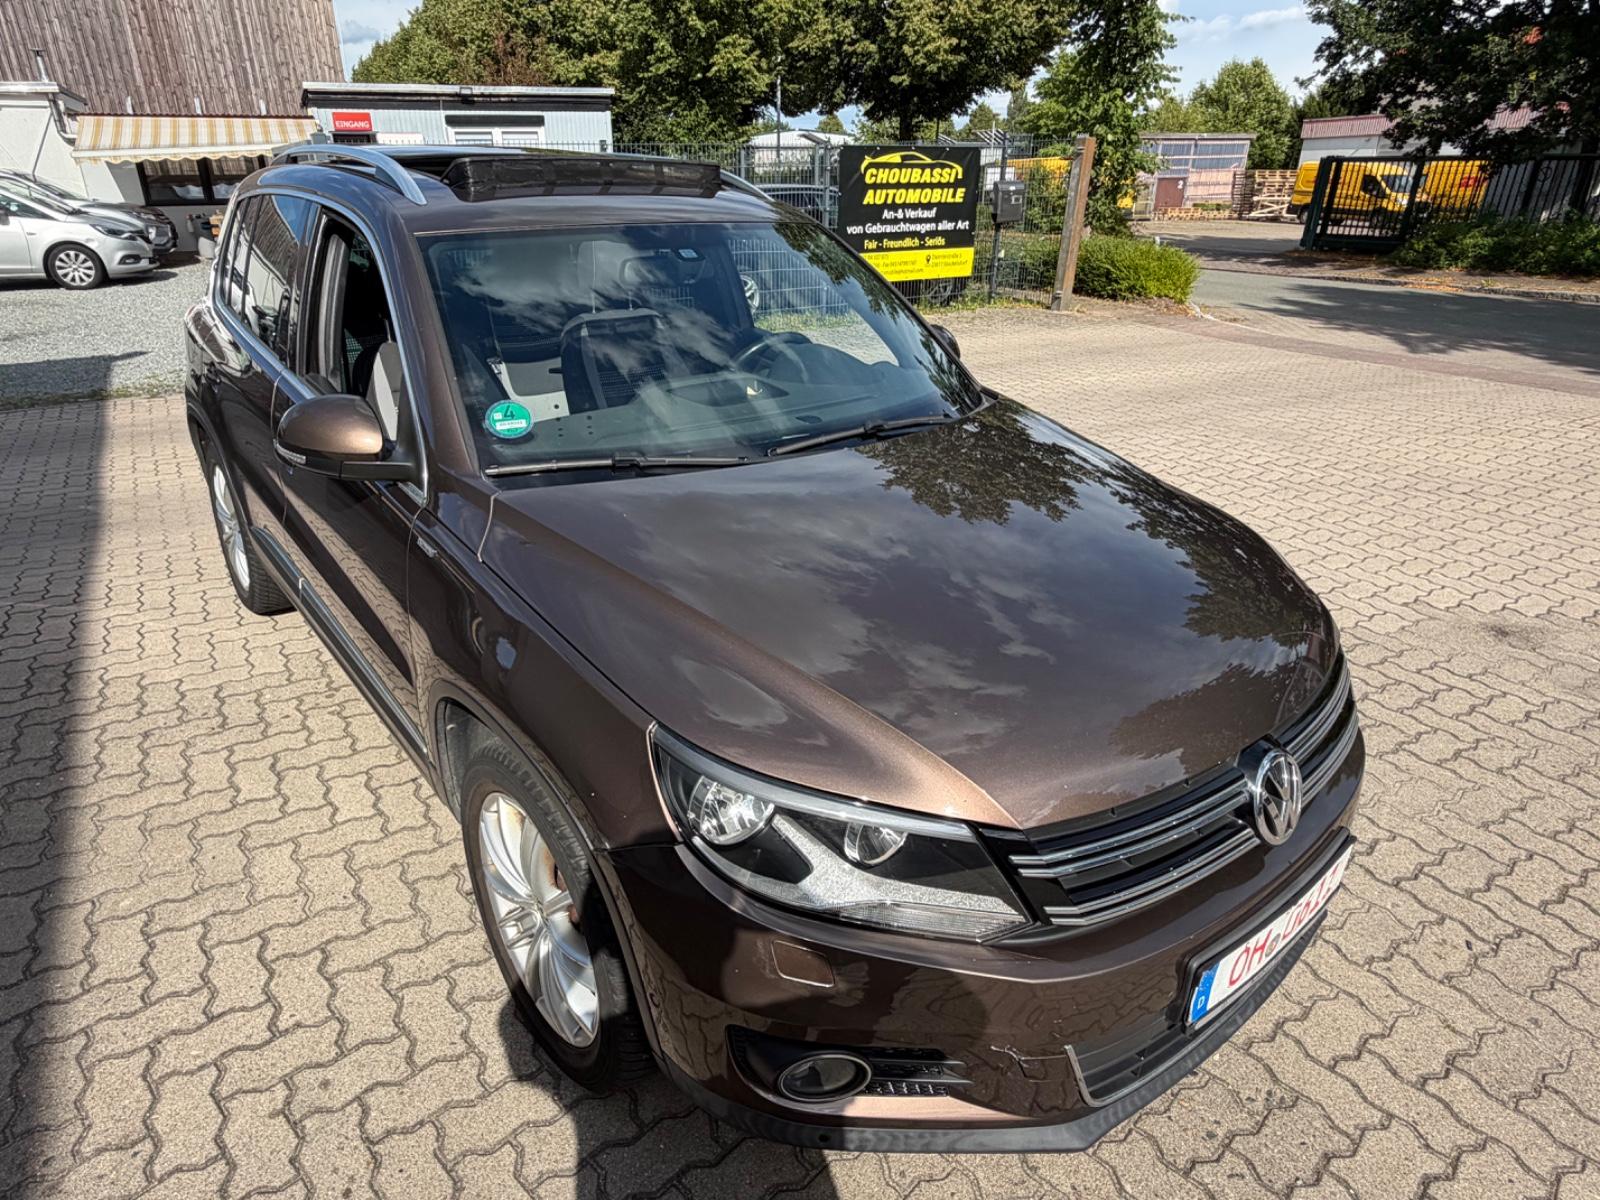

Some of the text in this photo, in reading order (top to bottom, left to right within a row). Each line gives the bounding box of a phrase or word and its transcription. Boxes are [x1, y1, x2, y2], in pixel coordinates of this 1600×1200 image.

[335, 120, 370, 129] EINGANG
[864, 167, 957, 185] CHOUBASSI
[1177, 180, 1184, 189] 2
[862, 187, 966, 205] AUTOMOBILE
[905, 206, 937, 219] Verkauf
[846, 220, 969, 235] von Gebrauchtwagen aller Art
[864, 239, 878, 250] Fair
[883, 237, 919, 249] Freundlich
[925, 236, 946, 247] Seriös
[504, 405, 515, 419] 4
[1228, 929, 1273, 988] OH
[1197, 996, 1205, 1009] D
